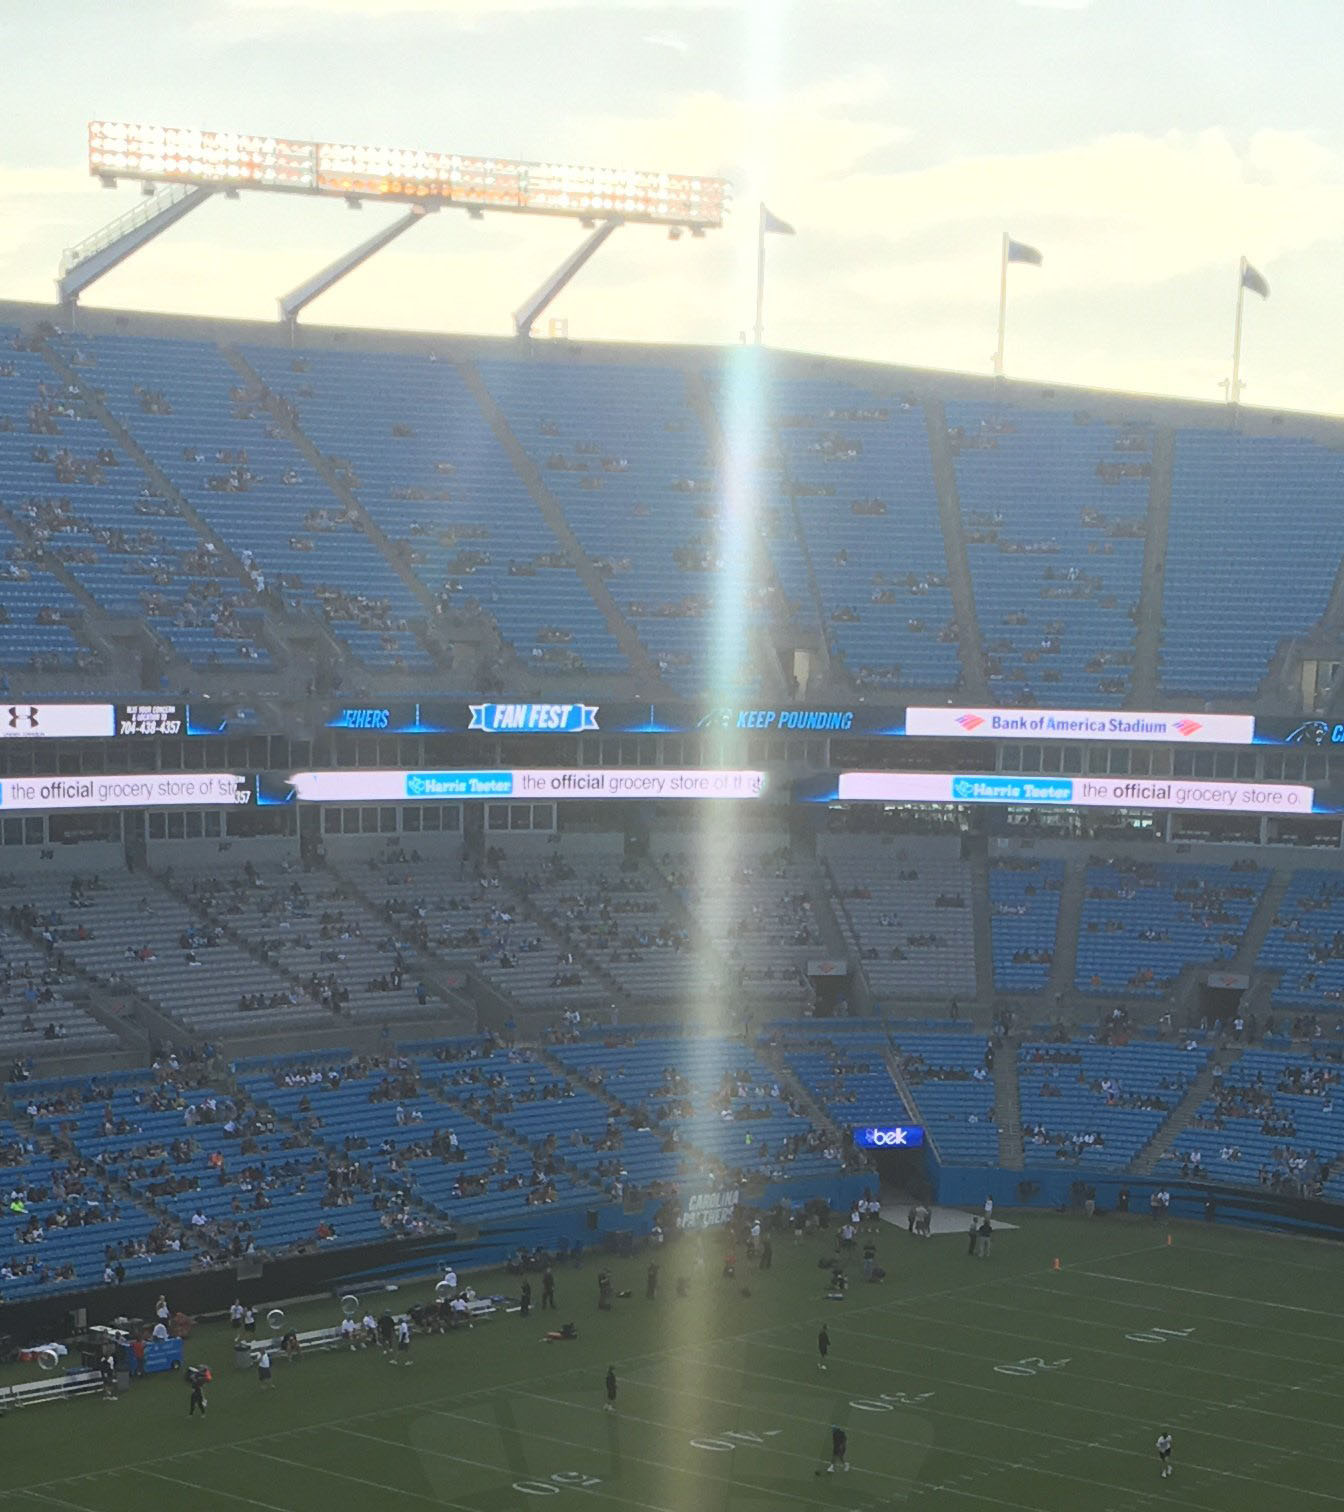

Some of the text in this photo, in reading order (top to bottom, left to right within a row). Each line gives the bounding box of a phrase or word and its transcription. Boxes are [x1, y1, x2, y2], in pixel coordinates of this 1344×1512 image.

[493, 703, 572, 728] FAN FEST
[736, 711, 853, 730] KEEP POUNDING
[992, 716, 1167, 733] Bank of America Stadium
[12, 783, 35, 799] the
[40, 780, 94, 799] official
[99, 783, 154, 801] grocery
[158, 781, 195, 796] store
[199, 779, 213, 795] of
[425, 778, 466, 793] Harris
[469, 778, 511, 792] Teeter
[523, 775, 546, 789] the
[551, 773, 605, 789] official
[609, 775, 666, 792] grocery
[671, 775, 710, 789] store
[973, 783, 1283, 805] Harris Teeter the official grocery store
[874, 1128, 907, 1145] belk
